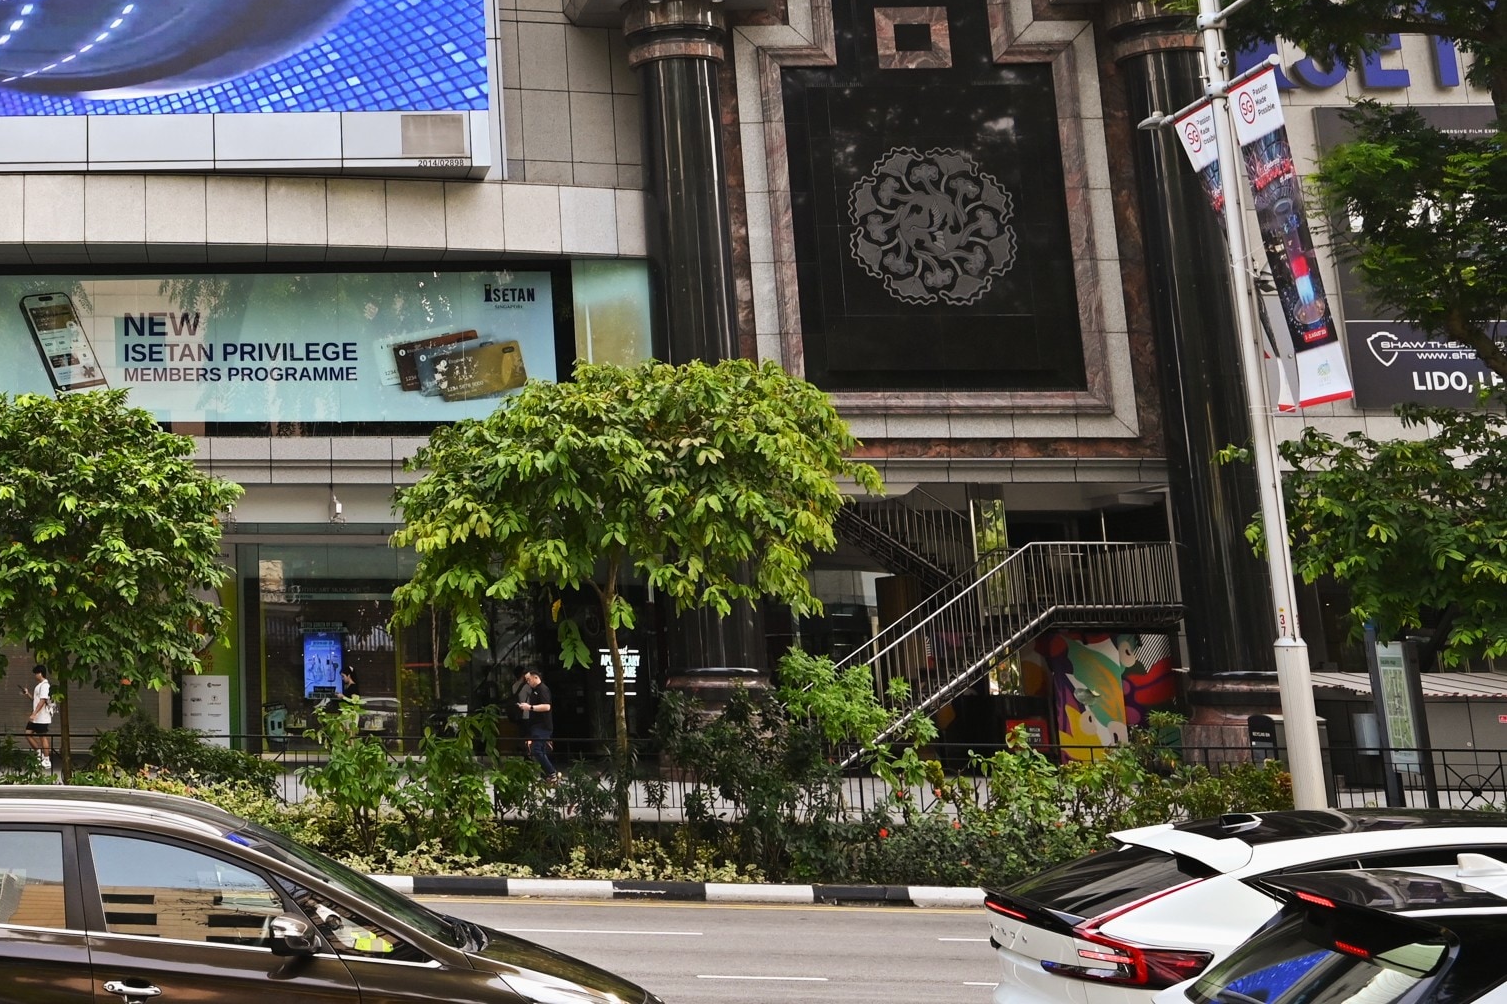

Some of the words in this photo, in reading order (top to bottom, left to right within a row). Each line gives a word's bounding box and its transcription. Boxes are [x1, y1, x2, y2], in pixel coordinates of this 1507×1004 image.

[1252, 83, 1269, 95] Passion
[1255, 95, 1267, 105] Made
[1258, 102, 1275, 116] Possible
[483, 283, 536, 303] ISETAN
[123, 312, 201, 337] NEW
[123, 342, 215, 363] ISETAN
[222, 342, 359, 362] PRIVILEGE
[123, 367, 221, 383] MEMBERS
[227, 366, 358, 382] PROGRAMME
